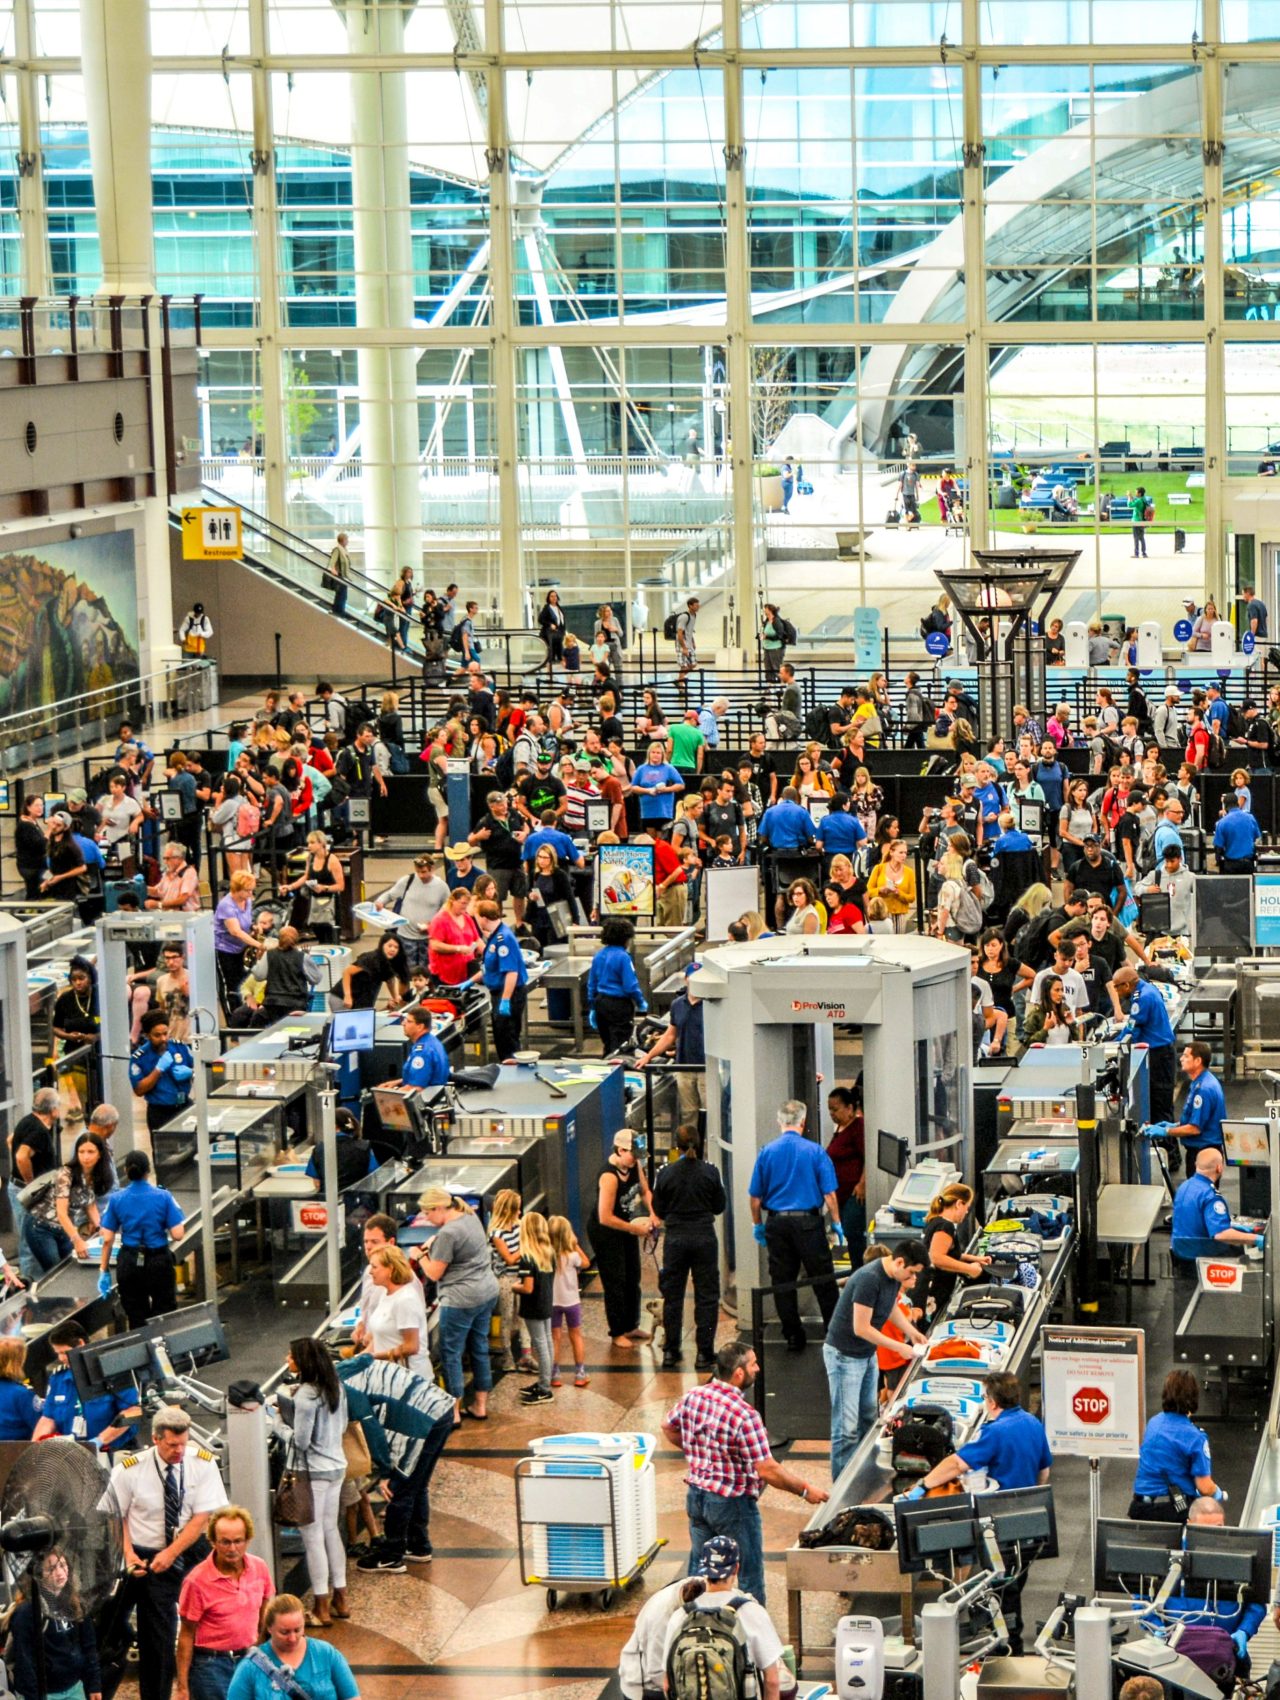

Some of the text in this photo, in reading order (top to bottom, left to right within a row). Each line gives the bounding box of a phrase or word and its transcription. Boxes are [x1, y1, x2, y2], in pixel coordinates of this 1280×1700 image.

[803, 1002, 845, 1010] ProVision
[827, 1010, 845, 1018] ATD
[194, 1039, 199, 1051] 3
[1082, 1048, 1088, 1059] 5
[324, 1096, 329, 1108] 4
[1271, 1107, 1276, 1119] 6
[303, 1212, 326, 1220] STOP
[1210, 1269, 1234, 1278] STOP
[1074, 1398, 1107, 1413] STOP
